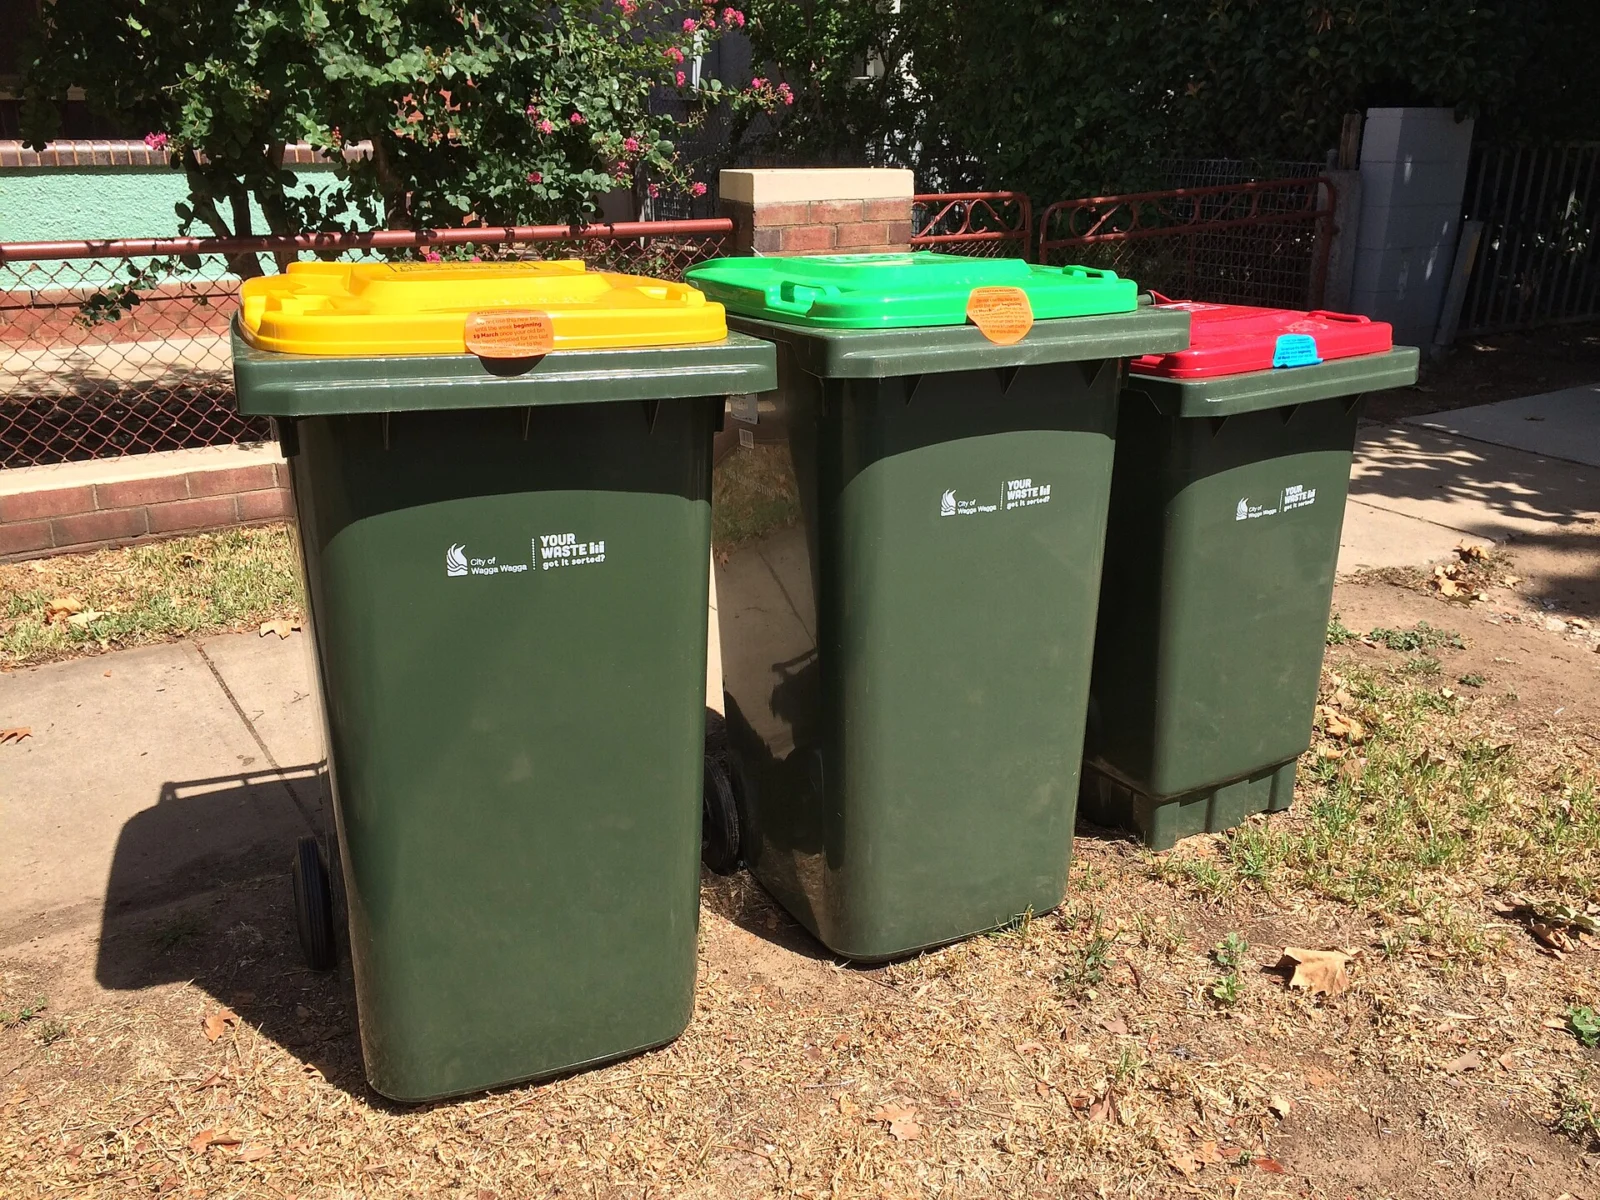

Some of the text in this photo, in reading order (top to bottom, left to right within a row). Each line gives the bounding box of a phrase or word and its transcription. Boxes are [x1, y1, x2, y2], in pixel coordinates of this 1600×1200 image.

[1007, 478, 1032, 490] YOUR
[1285, 484, 1303, 496] YOUR
[1006, 486, 1039, 501] WASTE
[1284, 491, 1308, 505] WASTE
[1006, 500, 1018, 510] got
[1027, 496, 1050, 505] sorted?
[540, 533, 576, 548] YOUR
[541, 543, 587, 559] WASTE
[470, 556, 496, 567] City of
[542, 554, 606, 570] got it sorted?
[471, 564, 528, 576] Wagga Wagga
